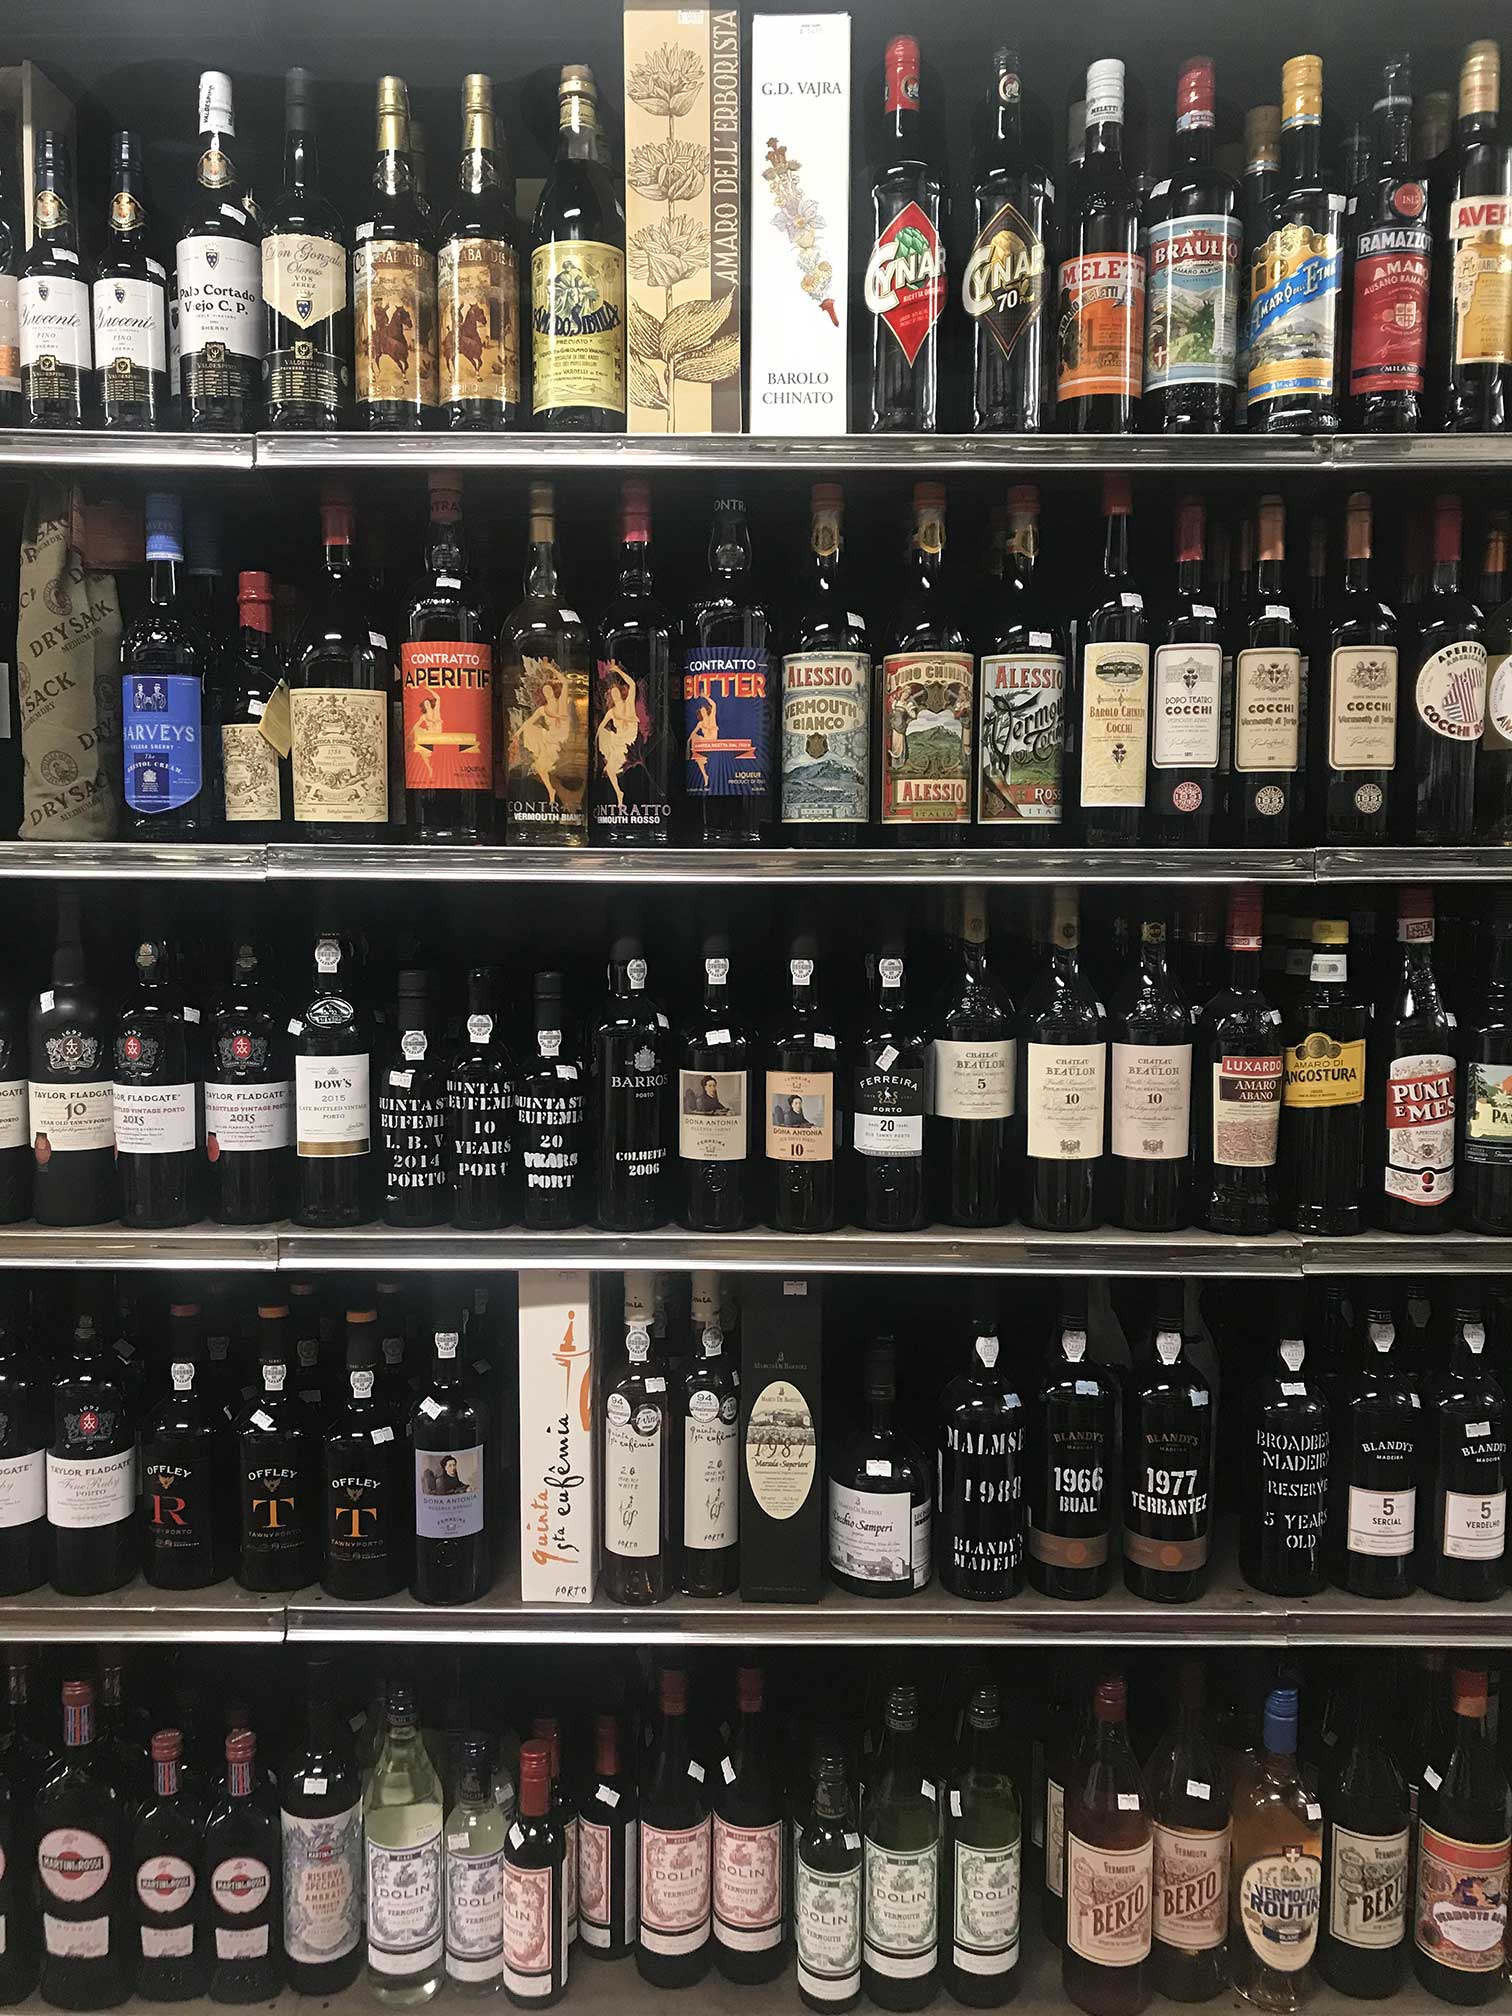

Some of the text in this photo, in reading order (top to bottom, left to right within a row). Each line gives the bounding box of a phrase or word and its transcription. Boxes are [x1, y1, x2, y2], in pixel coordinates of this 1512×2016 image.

[712, 9, 740, 133] ERBORISTA
[761, 81, 843, 98] G.D. VAJRA
[1090, 105, 1119, 116] MELETTI
[712, 198, 740, 283] AMARO
[296, 242, 343, 269] Gonzalo
[865, 240, 947, 317] CYNAR
[962, 243, 1046, 318] CYNAR
[203, 284, 256, 303] Cortado
[218, 302, 249, 316] C. P.
[996, 290, 1018, 313] 70
[1253, 281, 1291, 328] AMARO
[767, 371, 829, 389] BAROLO
[761, 392, 834, 408] CHINATO
[29, 600, 114, 659] DRY SACK
[411, 652, 480, 667] CONTRATTO
[689, 659, 757, 672] CONTRATTO
[786, 664, 853, 689] ALESSIO
[995, 665, 1063, 690] ALESSIO
[25, 671, 77, 714] SACK
[685, 673, 767, 701] BITTER
[1165, 696, 1213, 705] DOPO TEATRO
[1346, 702, 1391, 712] COCCHI
[784, 697, 859, 724] VERMOUTH
[1090, 706, 1119, 718] BAROLO
[1165, 705, 1212, 715] COCCHI
[1248, 703, 1294, 714] COCCHI
[792, 715, 845, 736] BIANCO
[1106, 722, 1133, 734] COCCHI
[1423, 704, 1471, 737] COCCHI
[903, 780, 964, 803] ALESSIO
[30, 785, 71, 827] DRY
[514, 812, 559, 822] VERMOUTH
[630, 815, 661, 824] ROSSO
[956, 1060, 1005, 1070] BEAULON
[1044, 1066, 1096, 1077] BEAULON
[1127, 1066, 1181, 1077] BEAULON
[1226, 1059, 1281, 1073] LUXARDO
[1293, 1059, 1344, 1071] AMARO DI
[314, 1078, 353, 1090] DOW'S
[611, 1073, 668, 1088] BARROS
[859, 1074, 919, 1091] FERREIRA
[976, 1077, 987, 1090] 5
[1234, 1080, 1277, 1091] AMARO
[127, 1093, 178, 1102] FLADGATE
[236, 1091, 281, 1101] FLADGATE
[635, 1091, 655, 1099] PORTO
[1238, 1091, 1274, 1101] ABANO
[1391, 1077, 1451, 1104] PUNT
[316, 1095, 347, 1103] 2015
[1063, 1093, 1080, 1105] 10
[1146, 1093, 1163, 1105] 10
[64, 1102, 87, 1121] 10
[130, 1106, 186, 1115] VINTAGE PORTO
[240, 1105, 271, 1113] VINTAGE
[872, 1105, 904, 1114] PORTO
[1394, 1097, 1456, 1123] E MES
[122, 1114, 145, 1126] 2015
[229, 1113, 256, 1125] 2015
[712, 1117, 740, 1127] ANTONIA
[474, 1120, 496, 1135] 10
[796, 1127, 824, 1136] ANTONIA
[879, 1119, 896, 1137] 20
[454, 1137, 512, 1155] YEARS
[539, 1134, 563, 1149] 20
[615, 1147, 667, 1162] COLHEITA
[789, 1142, 805, 1157] 10
[393, 1153, 441, 1169] 2014
[459, 1162, 510, 1177] PORT
[628, 1162, 660, 1177] 2006
[387, 1171, 446, 1188] PORTO
[697, 1393, 713, 1402] 94
[753, 1437, 808, 1459] 1987
[1360, 1441, 1415, 1454] BLANDY'S
[146, 1464, 192, 1478] OFFLEY
[247, 1467, 299, 1482] OFFLEY
[331, 1476, 382, 1490] OFFLEY
[1052, 1465, 1105, 1493] 1966
[1145, 1466, 1199, 1496] 1977
[1267, 1478, 1329, 1498] RESERVE
[150, 1493, 188, 1526] R
[1059, 1495, 1099, 1513] BUAL
[1131, 1490, 1207, 1517] TERRANTEZ
[1382, 1497, 1395, 1517] 5
[1480, 1500, 1492, 1520] 5
[251, 1496, 295, 1529] T
[1263, 1510, 1276, 1527] 5
[335, 1506, 378, 1538] T
[856, 1518, 894, 1538] Samperi
[1371, 1516, 1403, 1527] SERCIAL
[1285, 1534, 1318, 1550] OLD
[555, 1585, 589, 1599] PORTO
[1174, 1842, 1207, 1859] VERMOUTH
[307, 1868, 344, 1881] RISERVA
[654, 1865, 704, 1882] DOLIN
[718, 1861, 766, 1878] DOLIN
[1104, 1861, 1136, 1875] VERMOUTH
[379, 1882, 431, 1900] DOLIN
[663, 1888, 698, 1898] VERMOUTH
[722, 1884, 760, 1896] VERMOUTH
[876, 1887, 928, 1904] DOLIN
[972, 1884, 1018, 1902] DOLIN
[1161, 1870, 1218, 1918] BERTO
[388, 1904, 424, 1916] VERMOUTH
[801, 1903, 849, 1926] DOLIN
[883, 1911, 921, 1921] VERMOUTH
[1091, 1883, 1146, 1938] BERTO
[806, 1928, 842, 1943] VERMOUTH
